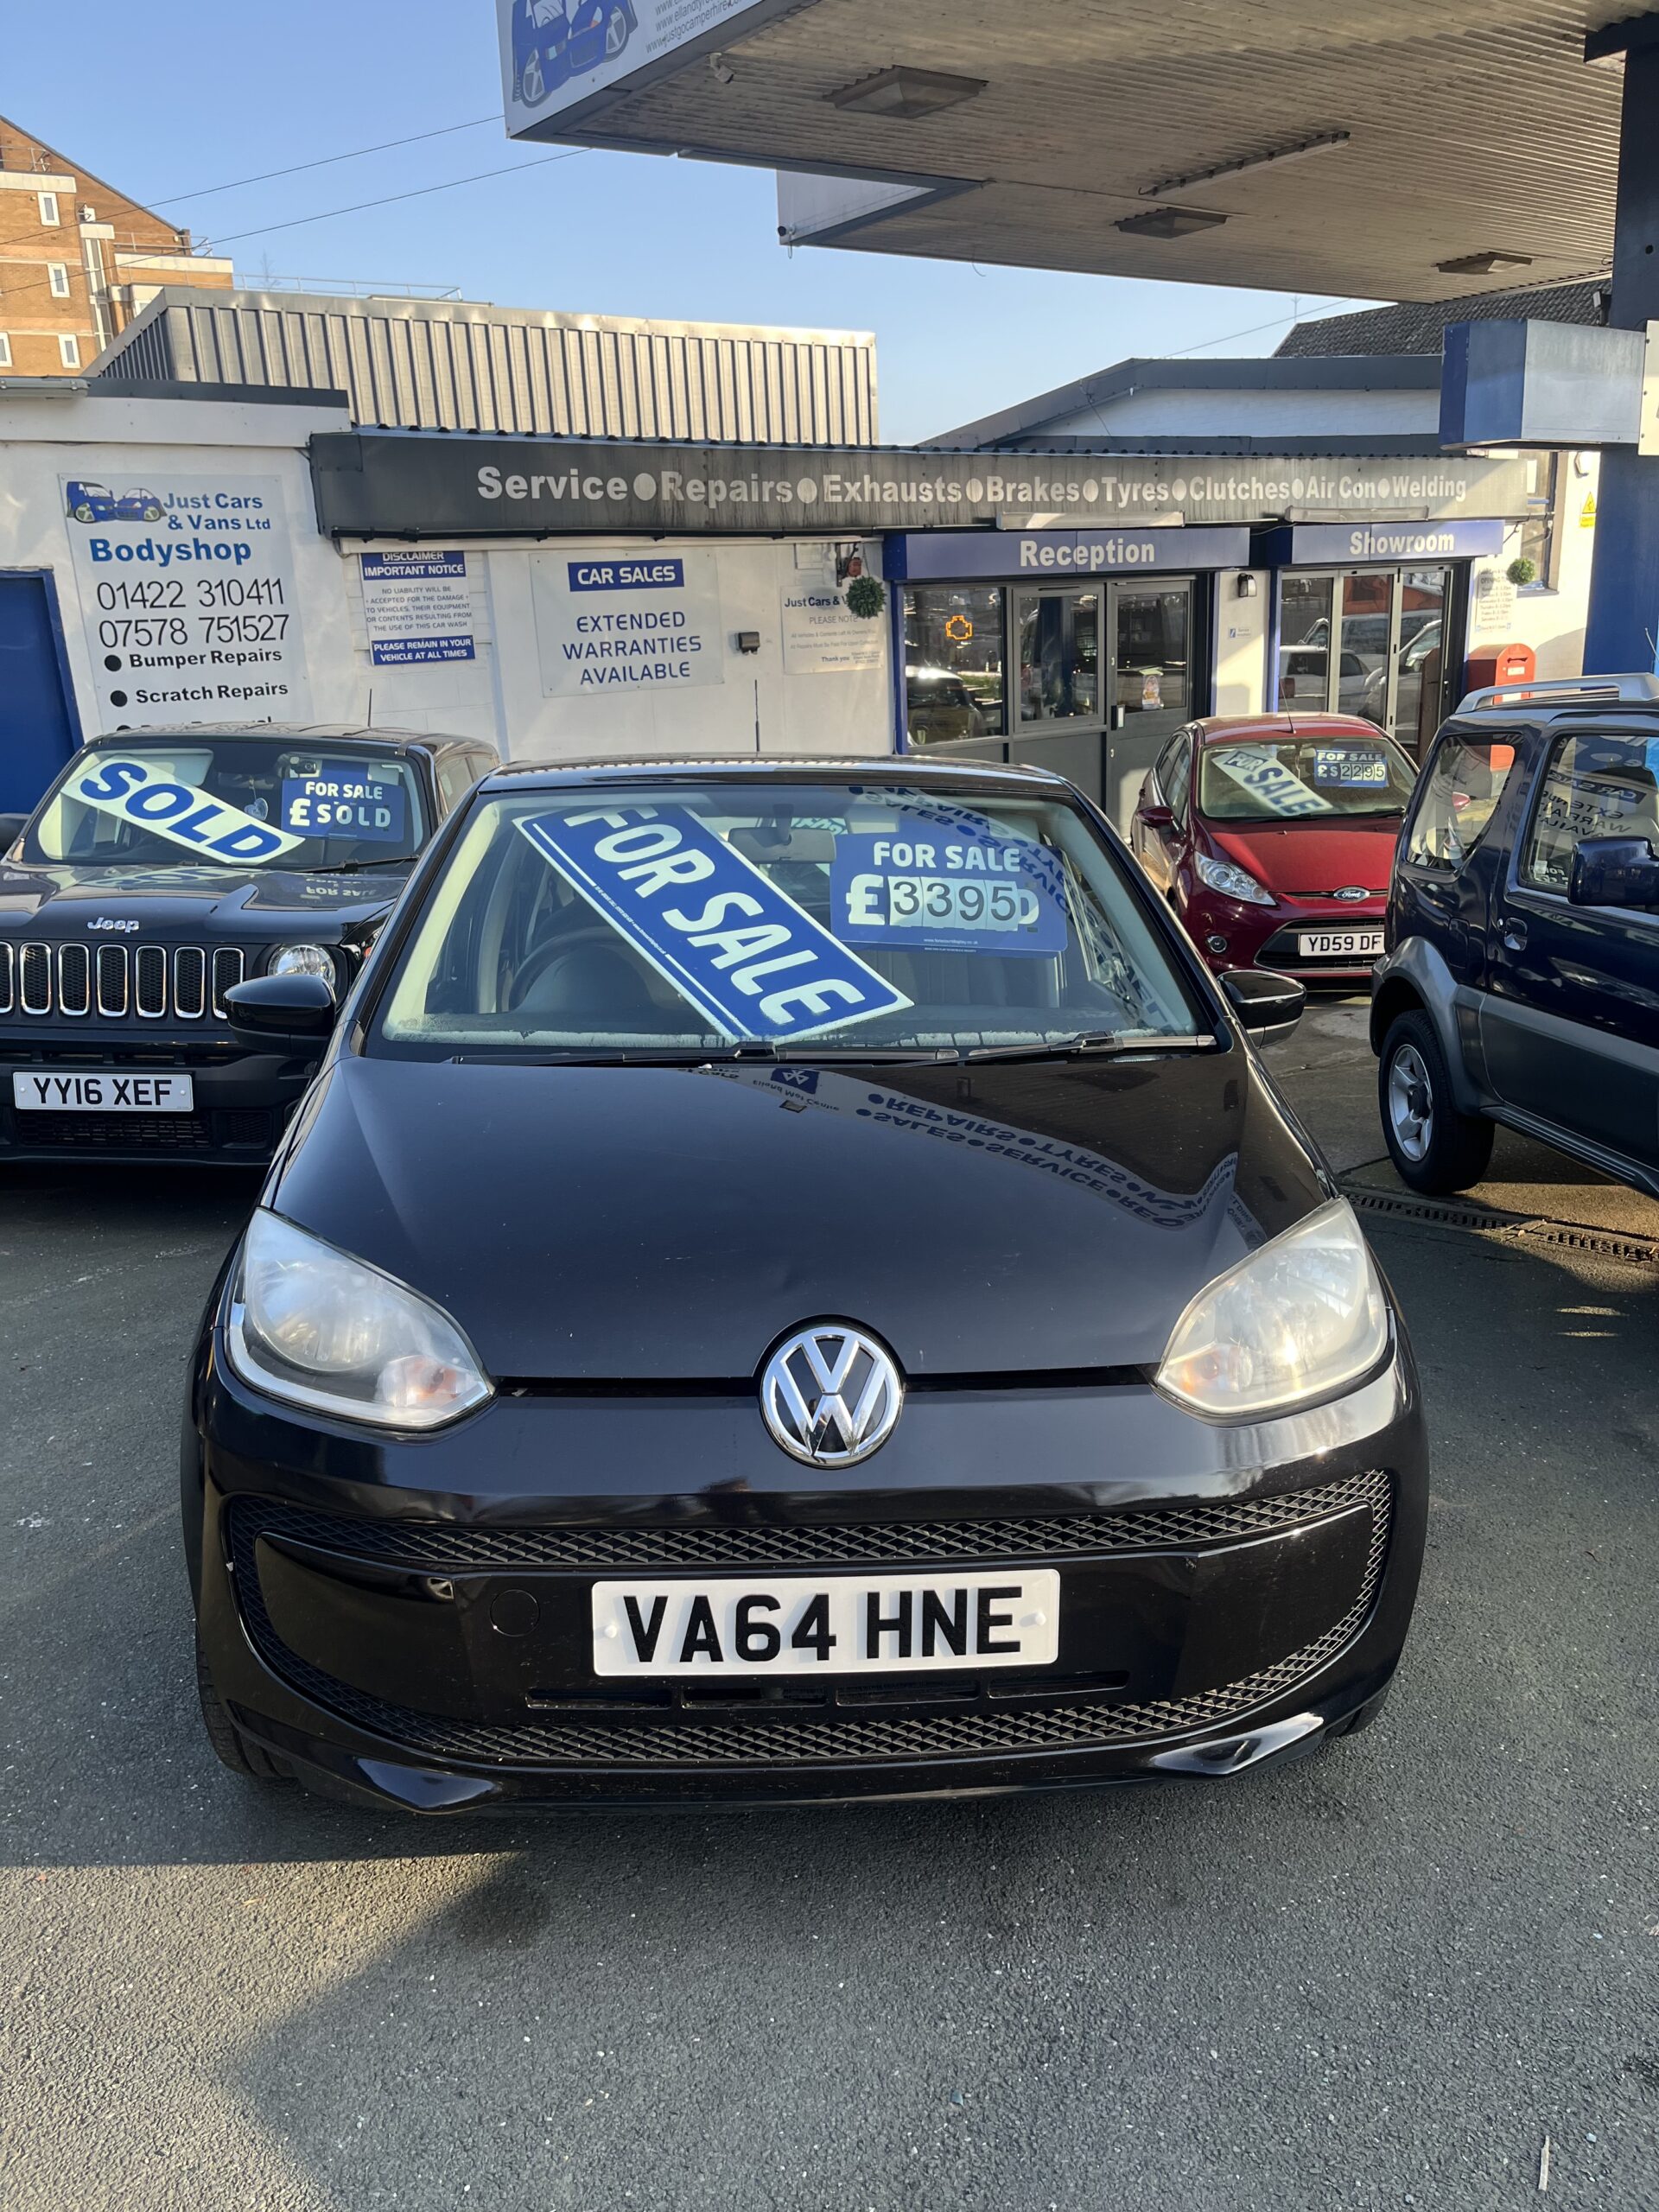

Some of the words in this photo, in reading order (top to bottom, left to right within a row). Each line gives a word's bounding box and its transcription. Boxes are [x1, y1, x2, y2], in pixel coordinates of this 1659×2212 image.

[478, 467, 627, 500] Service
[661, 471, 792, 508] Repairs
[823, 474, 961, 504] Exhausts
[987, 476, 1079, 502] Brakes
[1102, 477, 1168, 508] Tyres
[1190, 476, 1289, 500] Clutches
[1306, 477, 1335, 499] Air
[1339, 477, 1376, 499] Con
[1392, 475, 1466, 502] Welding
[163, 493, 210, 509] Just
[215, 493, 263, 509] Cars
[168, 515, 182, 530] &
[187, 515, 241, 530] Vans
[246, 518, 270, 530] Ltd
[89, 538, 251, 567] Bodyshop
[1350, 531, 1454, 555] Showroom
[382, 552, 444, 562] DISCLAIMER
[1020, 538, 1154, 570] Reception
[365, 565, 425, 576] IMPORTANT
[429, 564, 464, 575] NOTICE
[577, 569, 614, 585] CAR
[620, 566, 676, 583] SALES
[97, 581, 186, 610] 01422
[197, 578, 284, 607] 310411
[785, 598, 807, 607] Just
[808, 596, 831, 607] Cars
[833, 596, 840, 605] &
[576, 611, 685, 632] EXTENDED
[809, 615, 837, 625] PLEASE
[839, 614, 858, 623] NOTE
[99, 618, 188, 648] 07578
[199, 614, 289, 644] 751527
[373, 642, 405, 652] PLEASE
[407, 640, 438, 650] REMAIN
[449, 639, 472, 647] YOUR
[563, 636, 702, 660] WARRANTIES
[130, 653, 207, 669] Bumper
[211, 649, 283, 666] Repairs
[380, 652, 413, 662] VEHICLE
[428, 651, 442, 659] ALL
[580, 662, 690, 685] AVAILABLE
[136, 687, 213, 703] Scratch
[217, 683, 289, 700] Repairs
[1227, 753, 1265, 772] FOR
[1317, 752, 1345, 760] FOR
[305, 781, 339, 797] FOR
[343, 784, 383, 799] SALE
[1243, 767, 1324, 814] SALE
[79, 762, 283, 858] SOLD
[874, 842, 937, 868] FOR
[945, 845, 1020, 872] SALE
[563, 804, 715, 898] FOR
[661, 892, 866, 1025] SALE
[87, 917, 140, 933] Jeep
[1308, 936, 1354, 951] YD59
[1360, 935, 1382, 950] DF
[33, 1077, 103, 1105] YY16
[111, 1079, 172, 1106] XEF
[624, 1593, 837, 1663] VA64
[867, 1586, 1022, 1659] HNE
